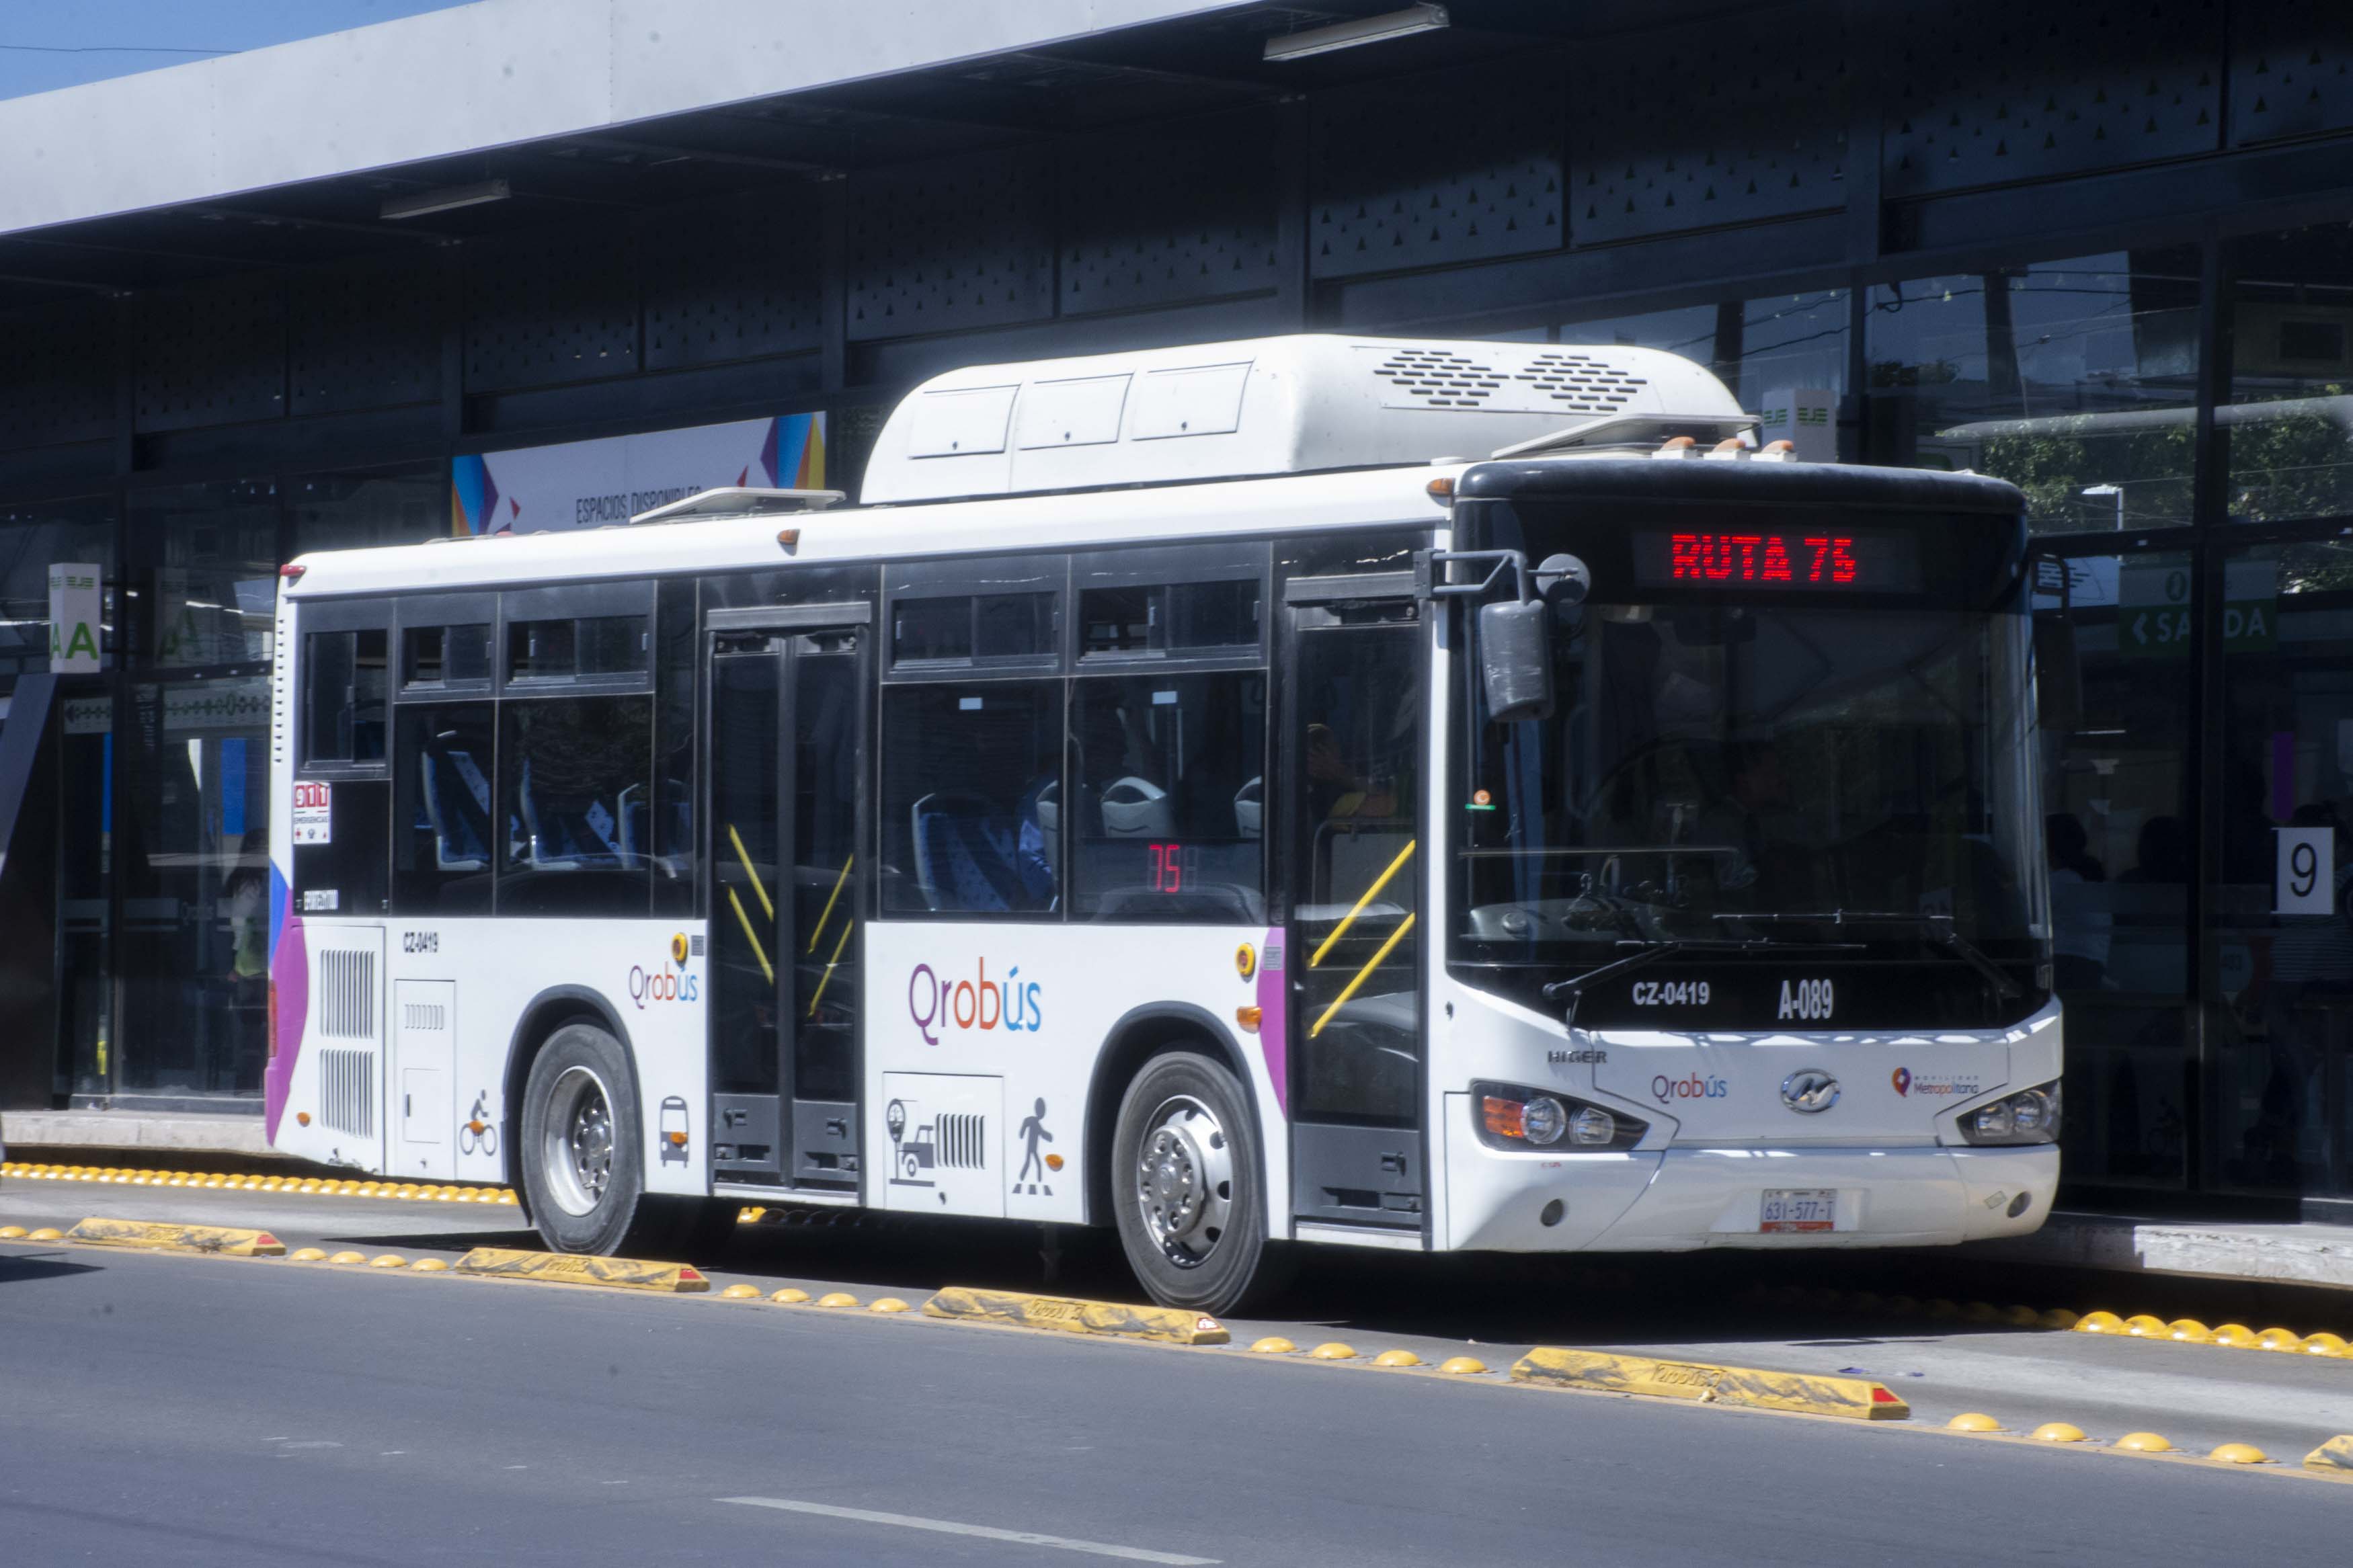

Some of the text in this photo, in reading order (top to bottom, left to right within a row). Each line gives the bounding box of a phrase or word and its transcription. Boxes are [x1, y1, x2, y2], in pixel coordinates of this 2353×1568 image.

[576, 493, 627, 524] ESPACIOS
[1672, 535, 1856, 581] RUTA 75
[66, 622, 98, 660] A
[2156, 607, 2267, 643] SADA
[296, 787, 327, 806] 911
[1149, 844, 1181, 893] 75
[2290, 843, 2316, 897] 9
[403, 932, 438, 953] CZ-0419
[629, 961, 698, 1009] Qrobús
[909, 956, 1041, 1046] Qrobús
[1633, 982, 1710, 1005] CZ-0419
[1778, 979, 1834, 1020] A-089
[1548, 1050, 1607, 1063] HIGER
[1652, 1073, 1727, 1104] Qrobús
